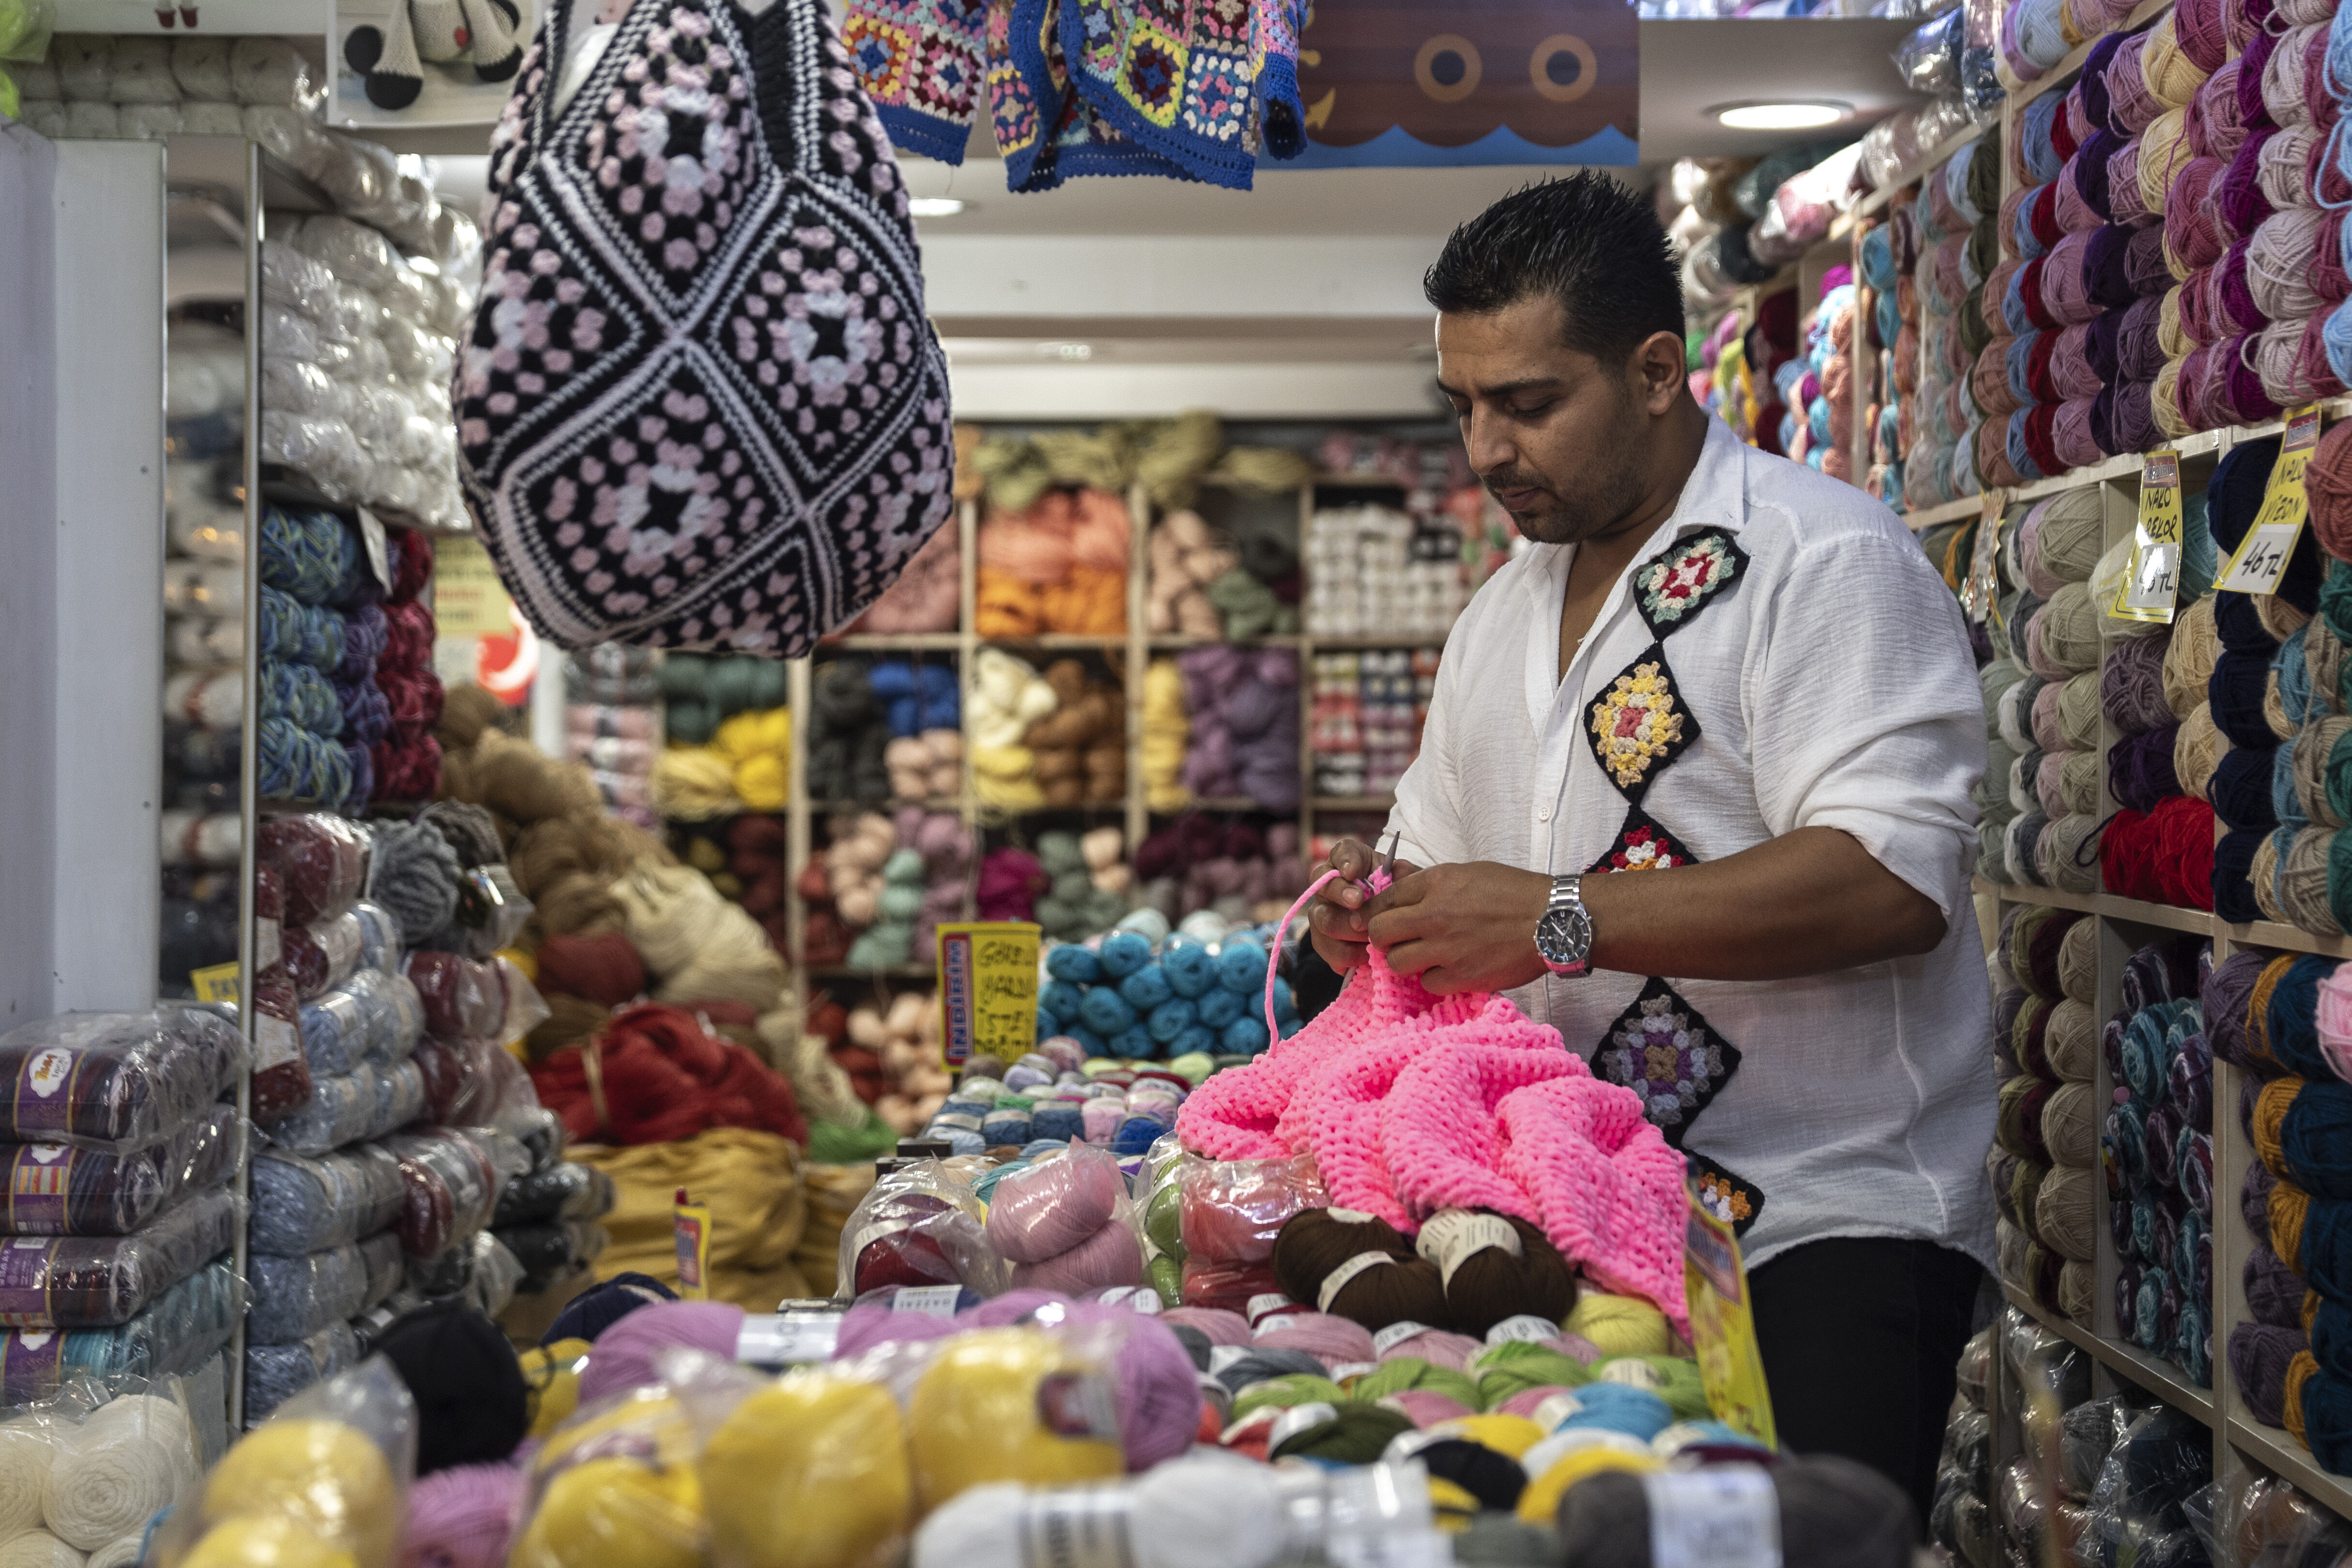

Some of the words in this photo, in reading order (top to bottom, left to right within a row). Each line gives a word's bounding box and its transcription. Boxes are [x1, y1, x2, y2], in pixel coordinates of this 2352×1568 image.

[2241, 541, 2272, 576] 46
[2260, 549, 2284, 578] TL
[2160, 571, 2173, 594] TL
[948, 940, 968, 1058] İNDİRİM
